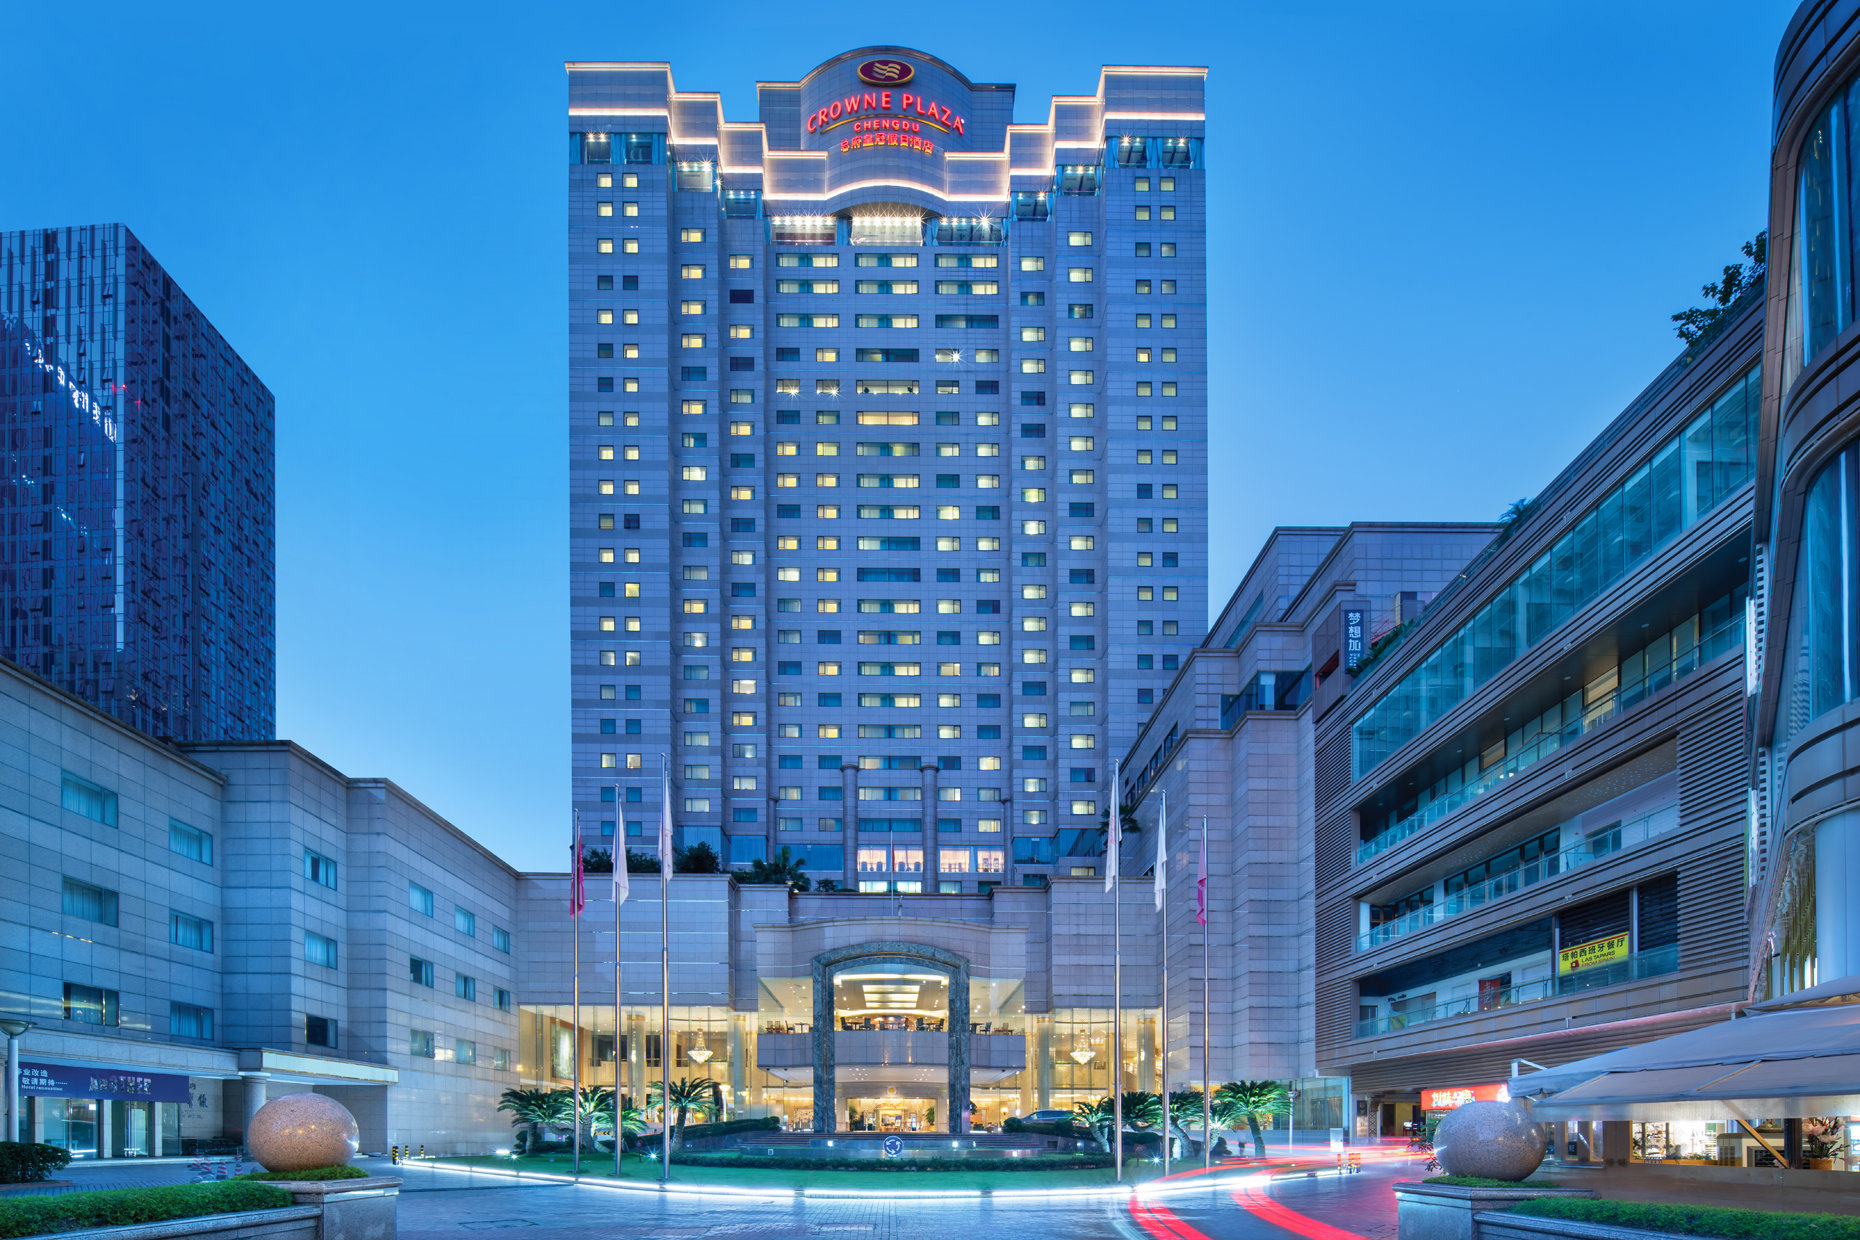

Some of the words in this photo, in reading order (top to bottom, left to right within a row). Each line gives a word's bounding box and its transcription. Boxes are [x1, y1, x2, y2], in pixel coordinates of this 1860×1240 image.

[807, 91, 891, 133] CROWNE
[902, 93, 963, 135] PLAZA
[853, 119, 920, 132] CHENGDU
[1348, 612, 1361, 651] 梦想加
[1562, 937, 1625, 961] 塔帕西班牙餐厅
